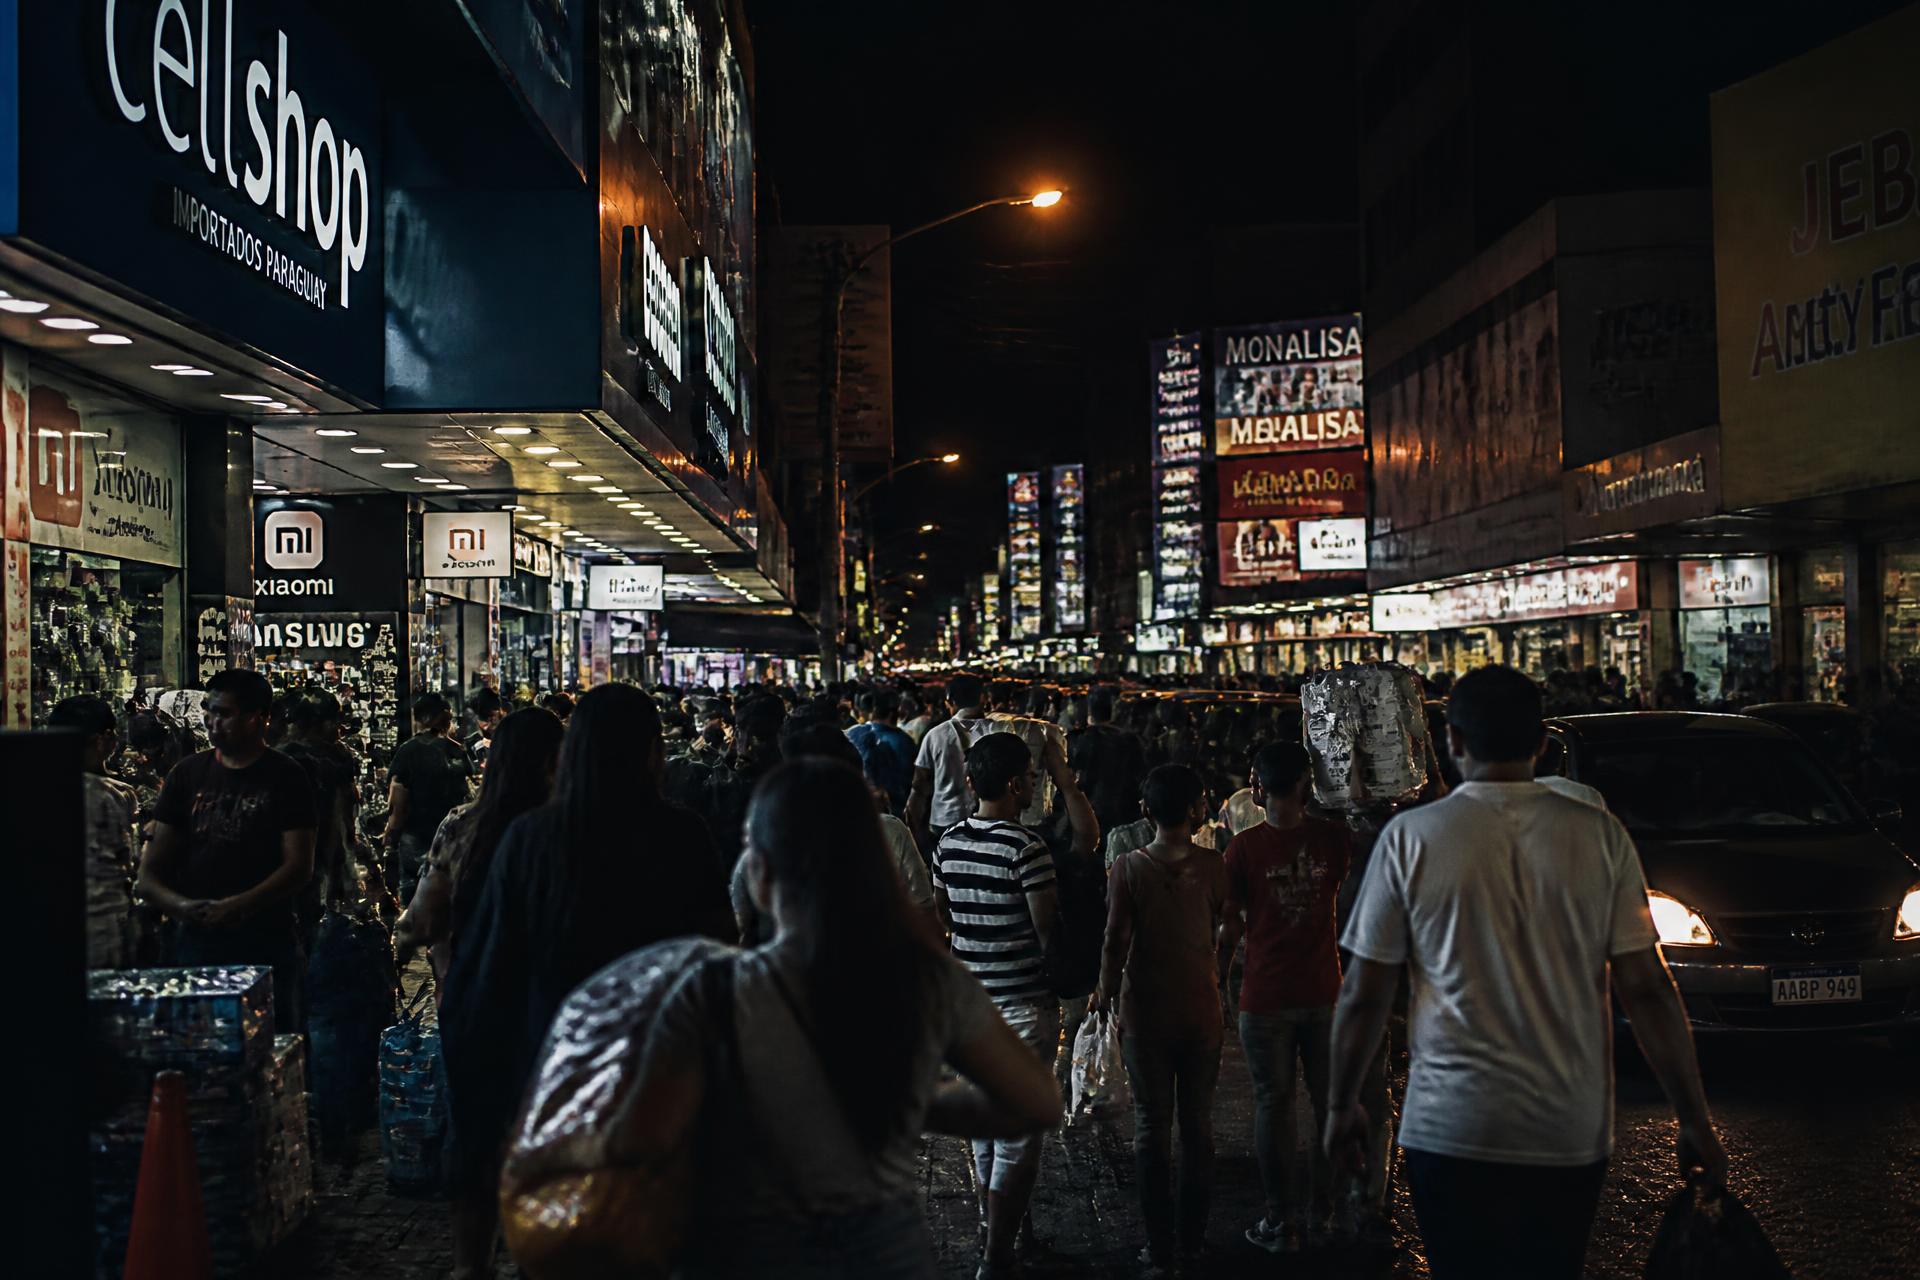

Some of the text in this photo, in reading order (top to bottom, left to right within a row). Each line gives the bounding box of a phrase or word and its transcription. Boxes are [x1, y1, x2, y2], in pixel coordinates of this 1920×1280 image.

[1790, 127, 1920, 257] JEB
[173, 186, 327, 311] IMPORTADOS PARAGUAY
[1225, 326, 1363, 366] MONALISA
[255, 577, 335, 596] xiaomi
[1777, 977, 1857, 1001] AABP 949
